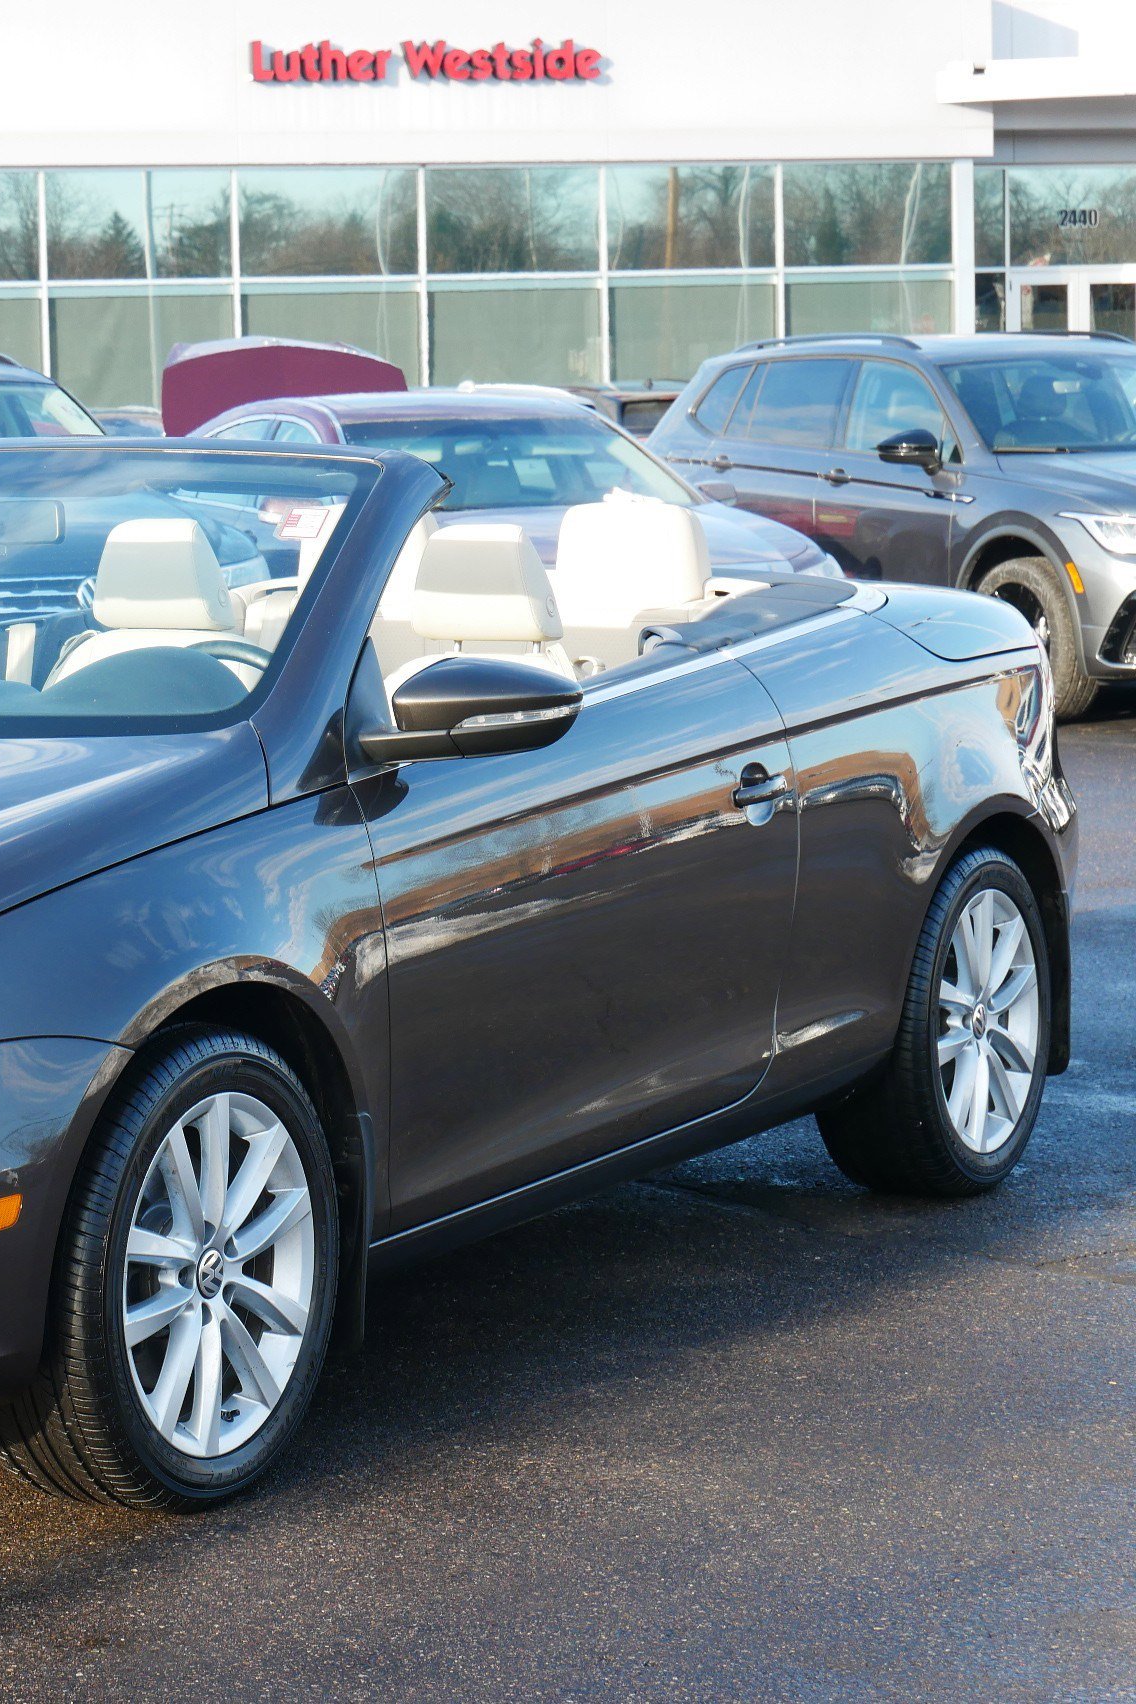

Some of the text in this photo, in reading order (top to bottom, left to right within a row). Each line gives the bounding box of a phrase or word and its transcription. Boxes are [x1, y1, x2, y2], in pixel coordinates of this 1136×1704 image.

[250, 37, 603, 82] Luther Westside
[1057, 208, 1099, 228] 2440
